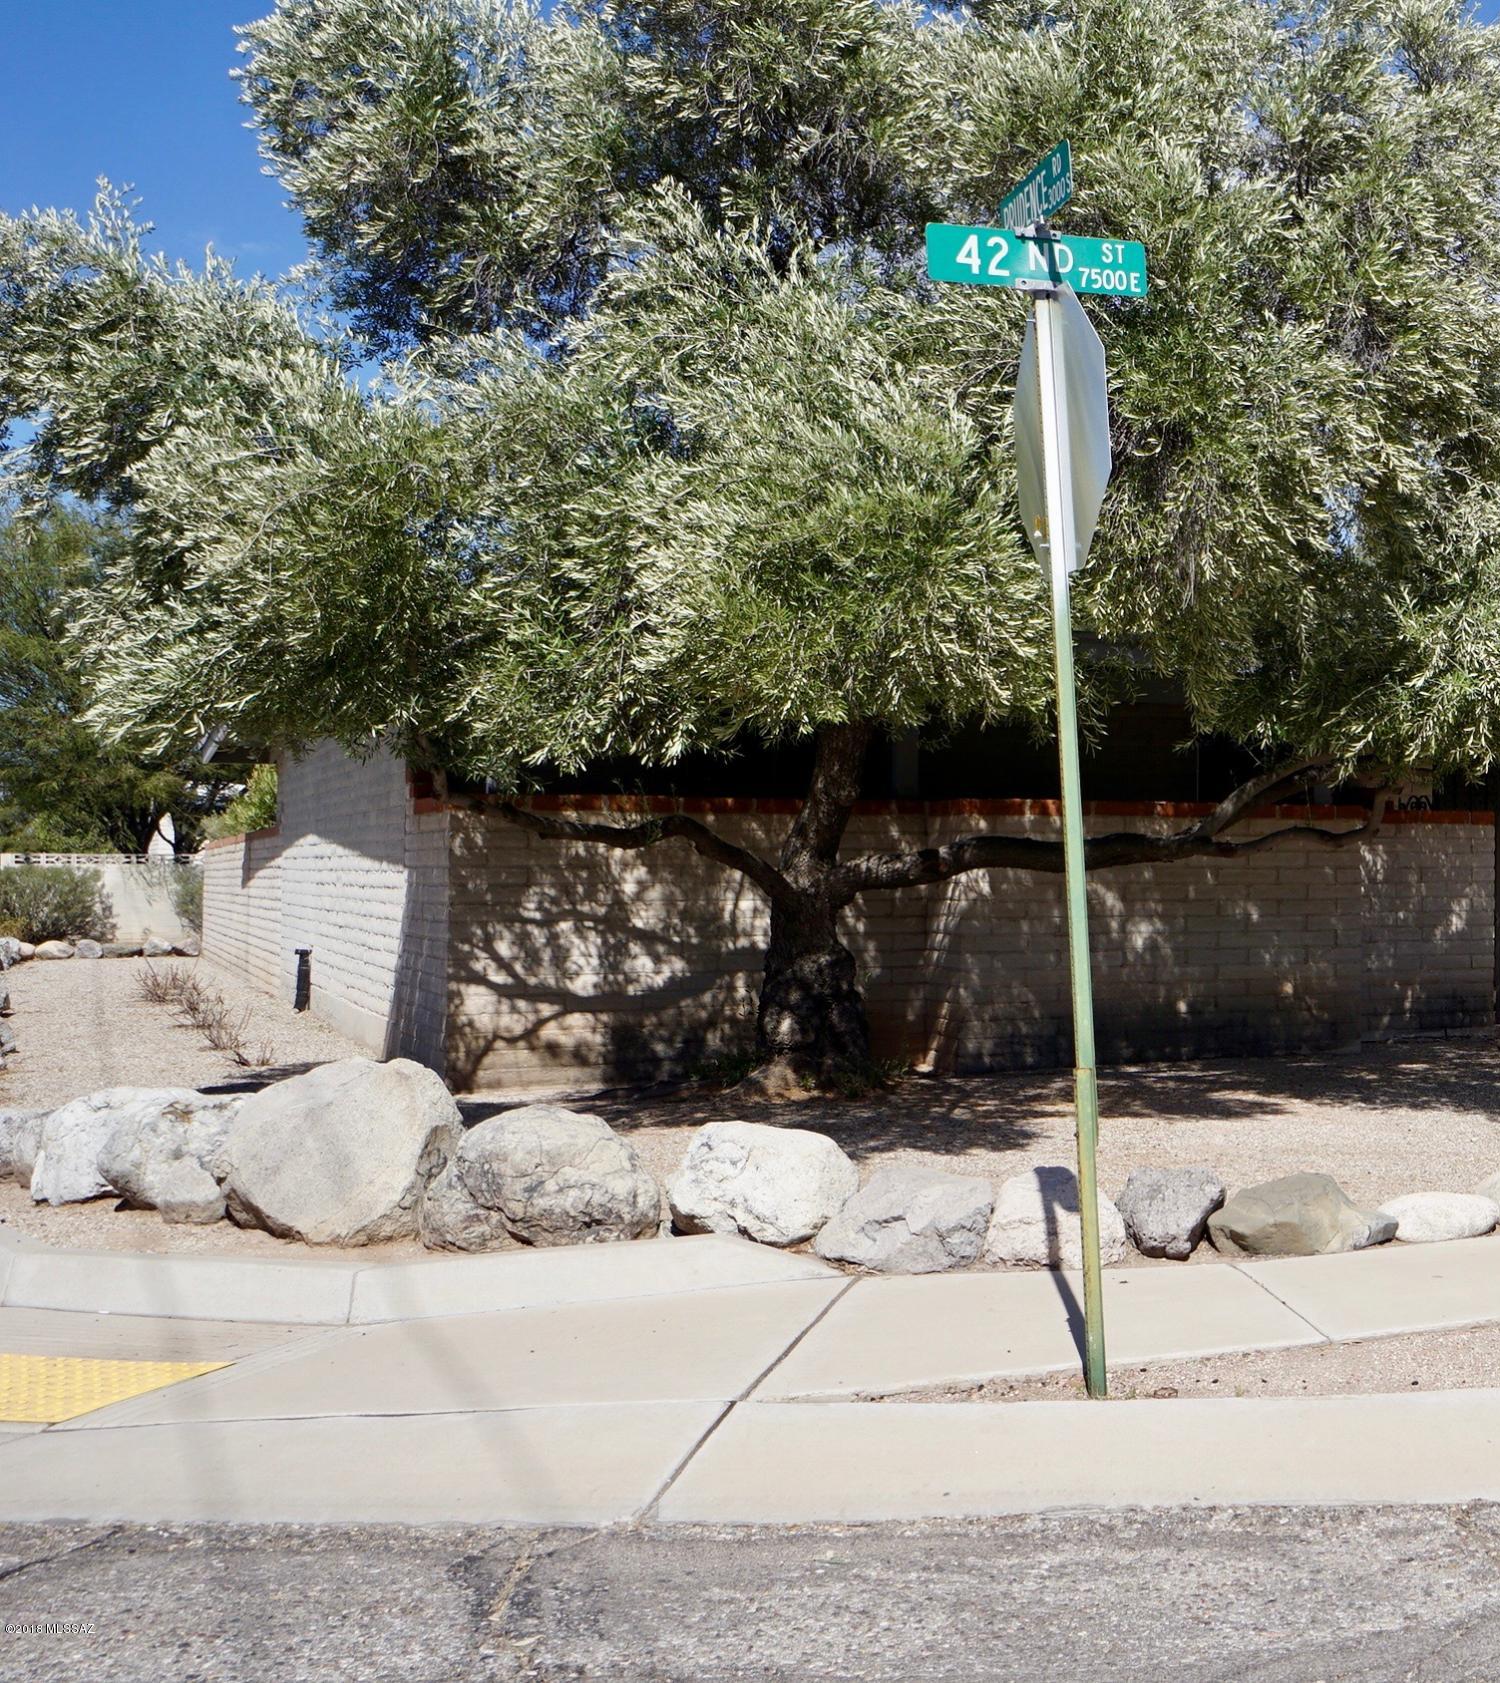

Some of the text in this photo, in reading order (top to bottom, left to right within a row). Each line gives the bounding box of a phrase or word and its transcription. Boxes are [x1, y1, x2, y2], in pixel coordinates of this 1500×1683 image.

[1004, 152, 1062, 230] PRUDENCE RD
[956, 234, 1125, 277] 42 ND ST
[1078, 267, 1141, 293] 7500 E
